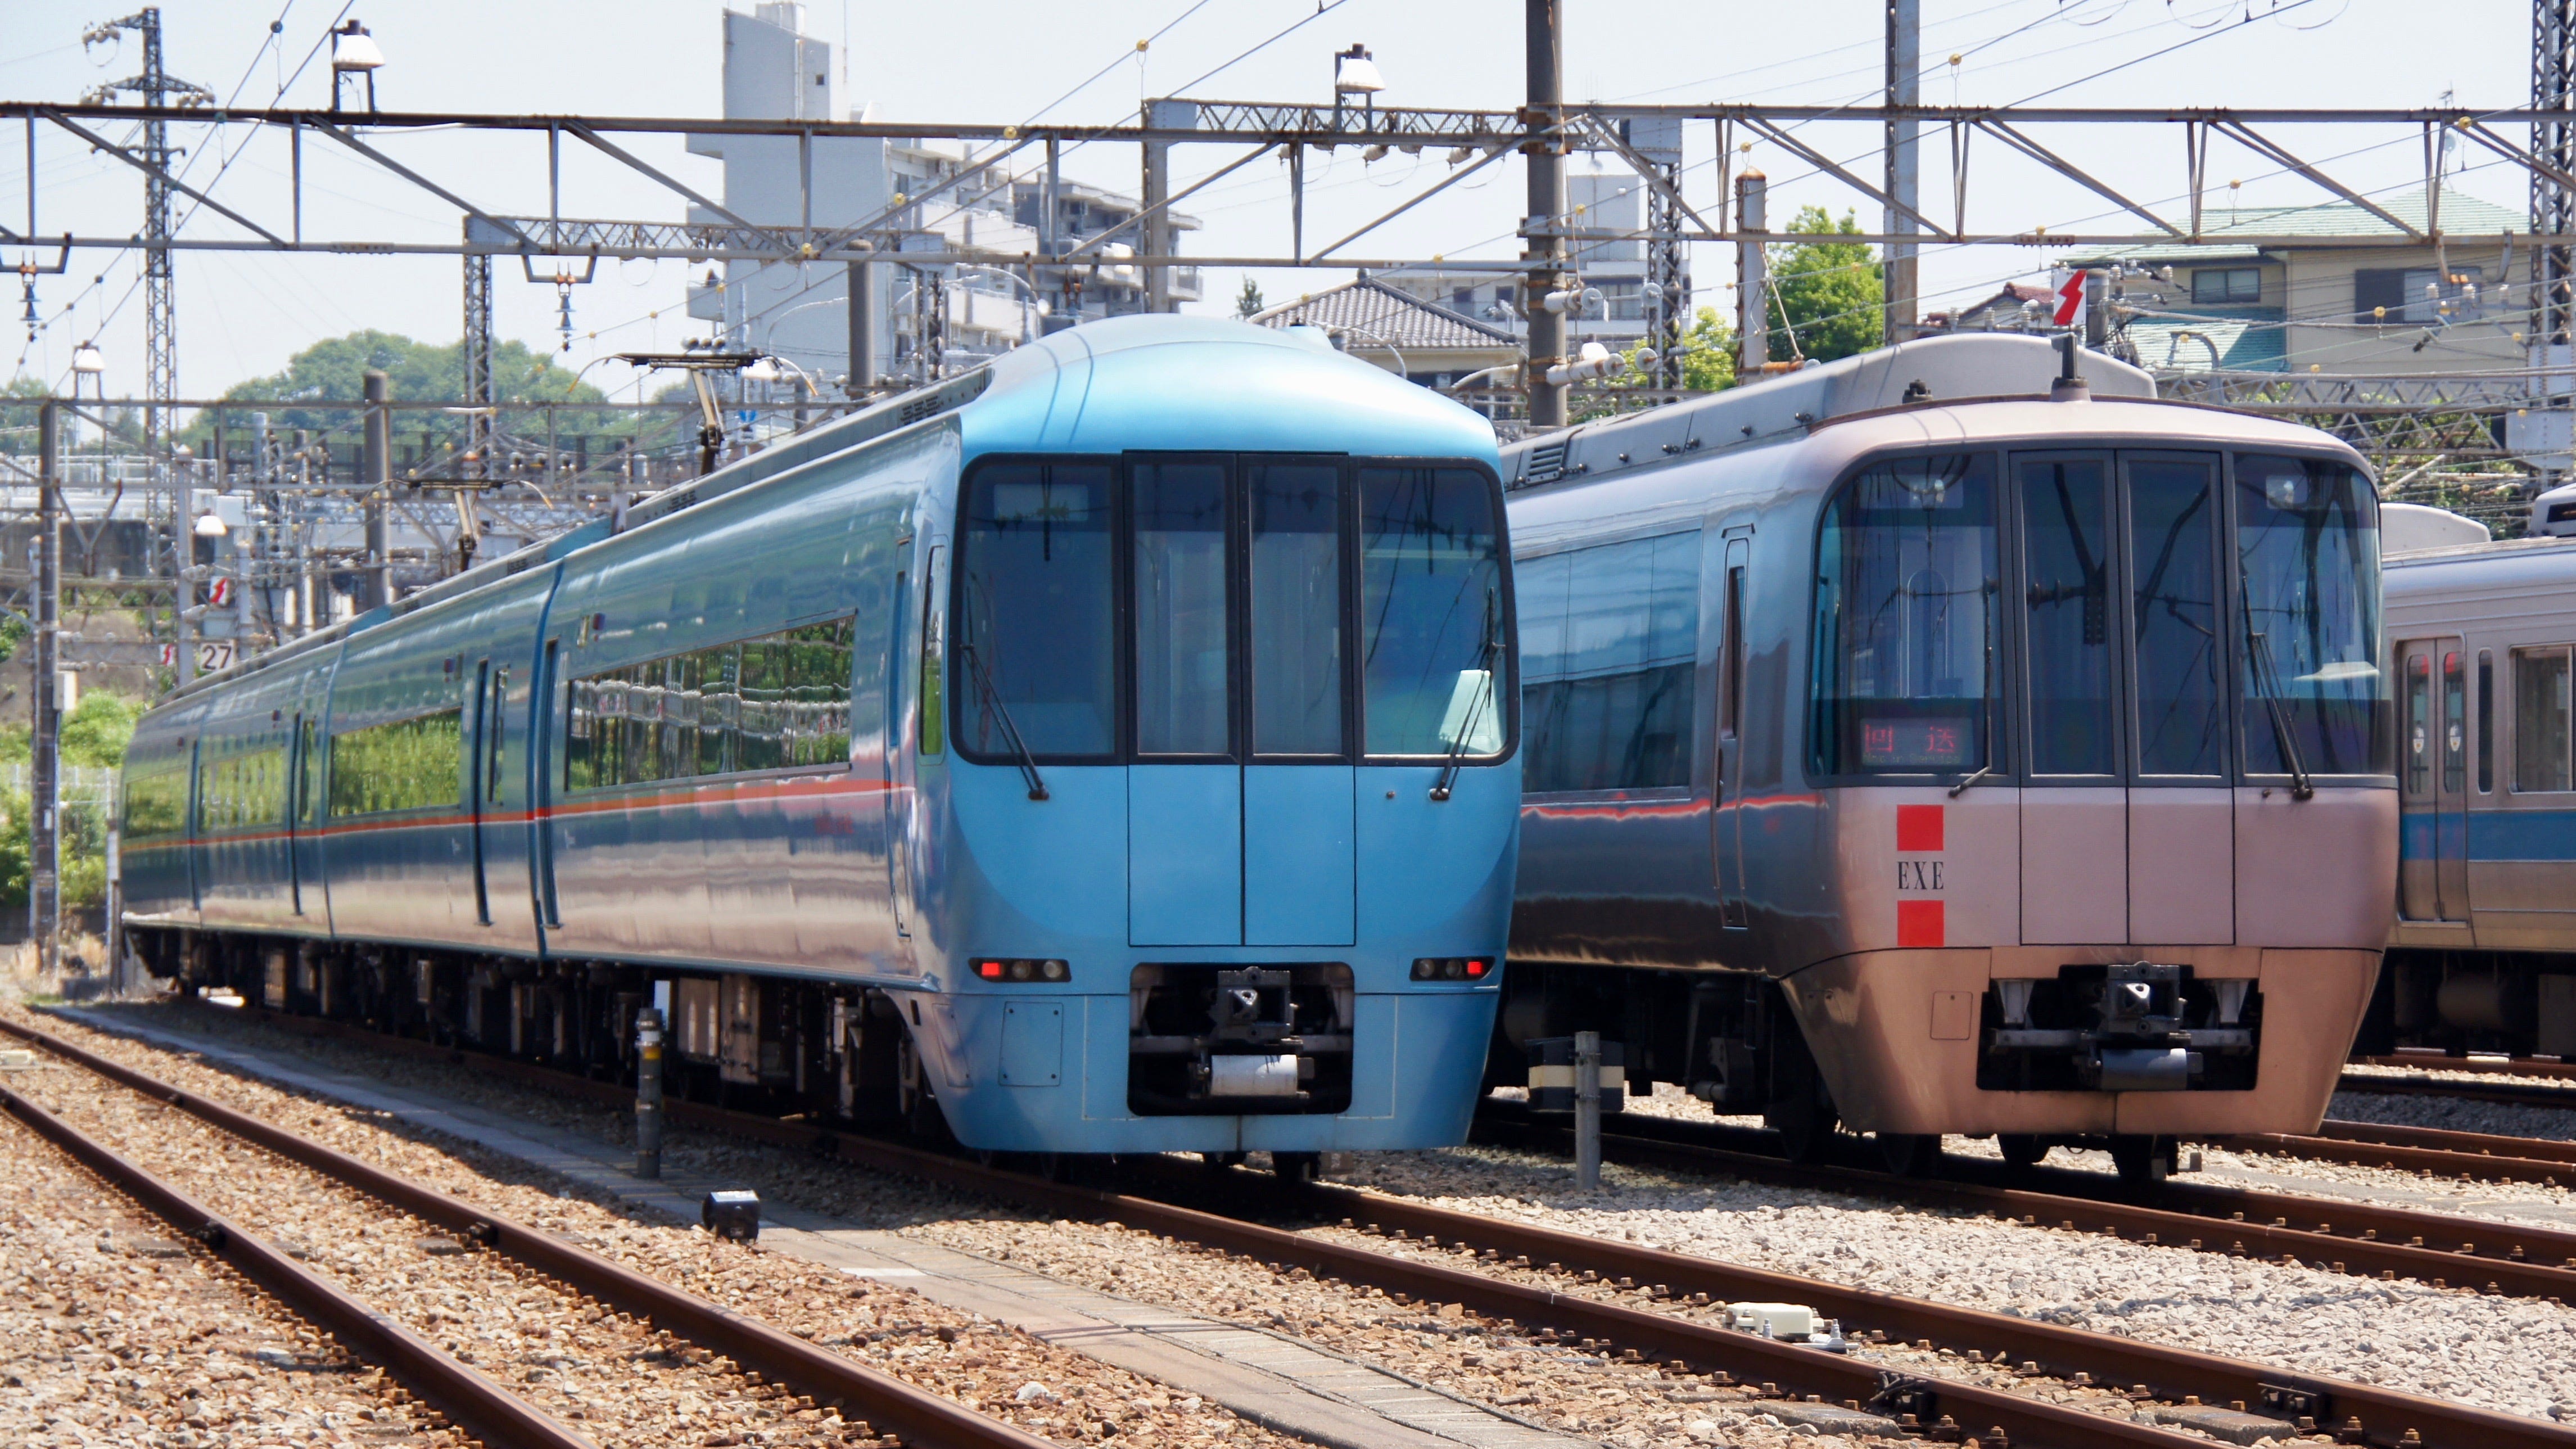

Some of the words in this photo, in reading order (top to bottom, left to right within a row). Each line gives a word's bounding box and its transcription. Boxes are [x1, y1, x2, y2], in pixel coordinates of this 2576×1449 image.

[202, 645, 232, 670] 27
[1865, 724, 1956, 753] 回送
[1897, 861, 1944, 890] EXE
